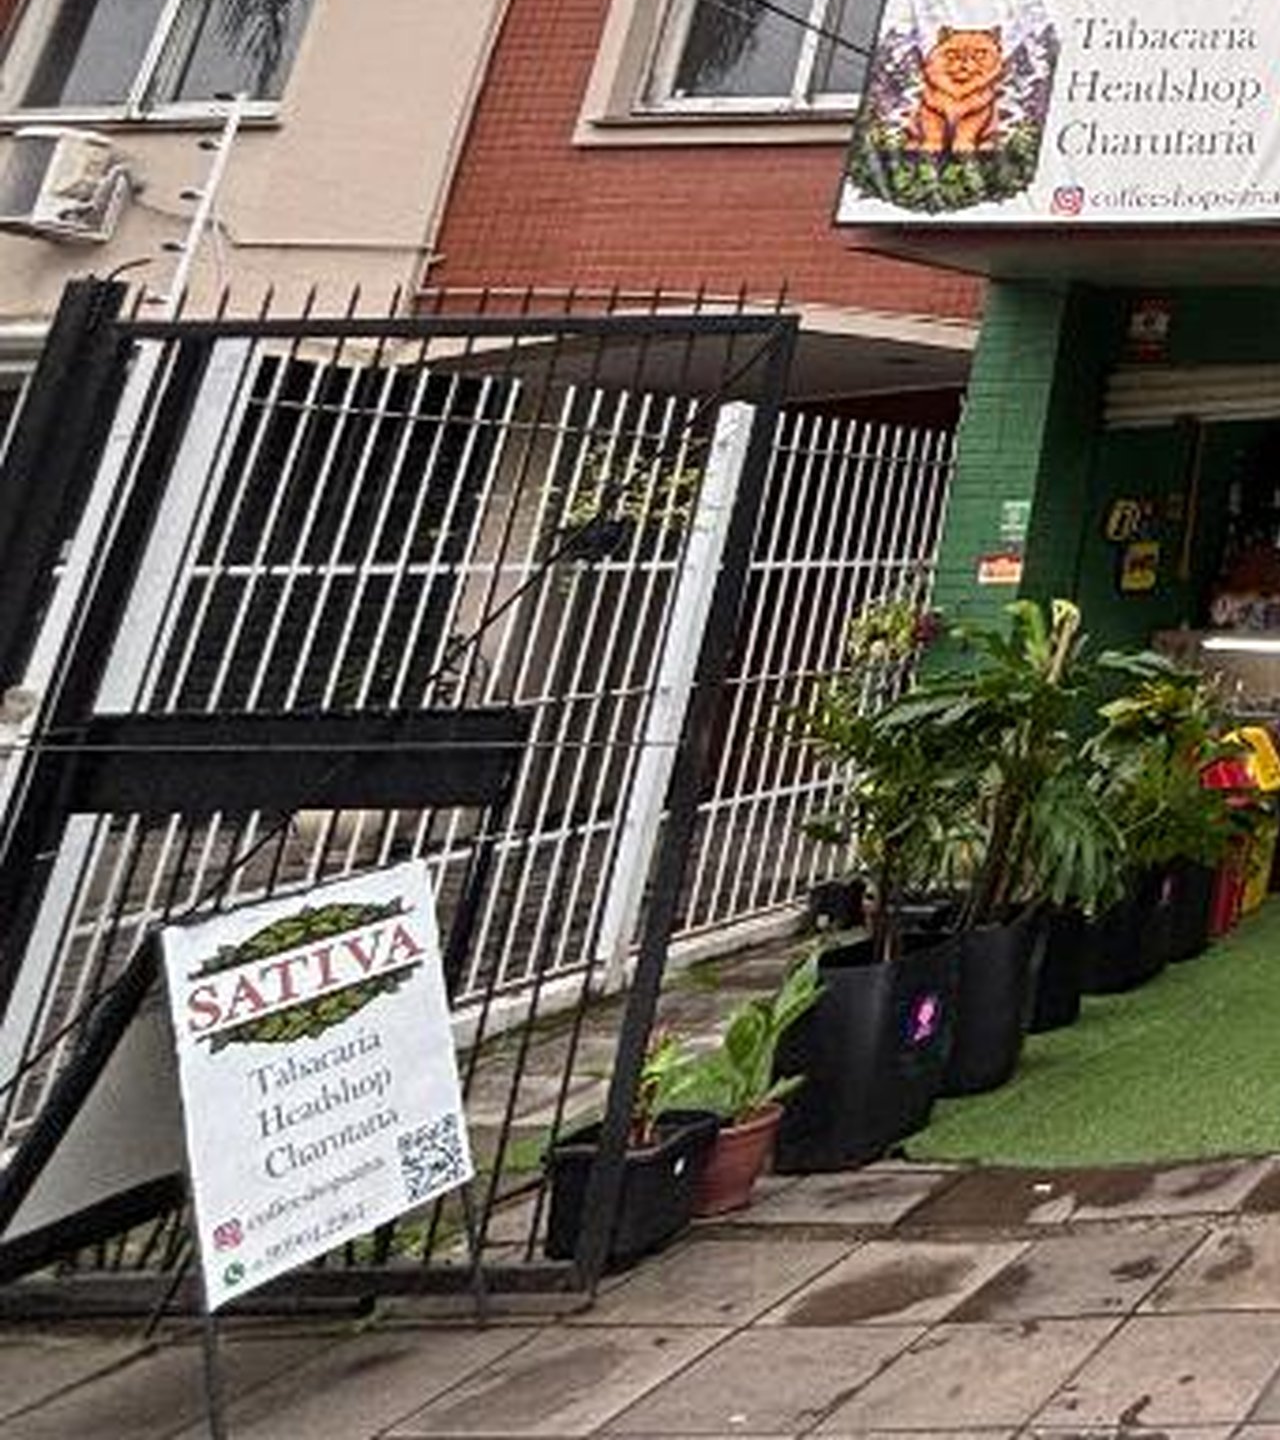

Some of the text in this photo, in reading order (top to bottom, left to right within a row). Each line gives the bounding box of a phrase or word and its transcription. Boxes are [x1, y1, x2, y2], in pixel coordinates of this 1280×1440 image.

[1074, 17, 1257, 50] Tabacaria
[1067, 68, 1262, 109] Headshop
[1056, 119, 1257, 156] Charutaria
[186, 921, 424, 1034] SATIVA
